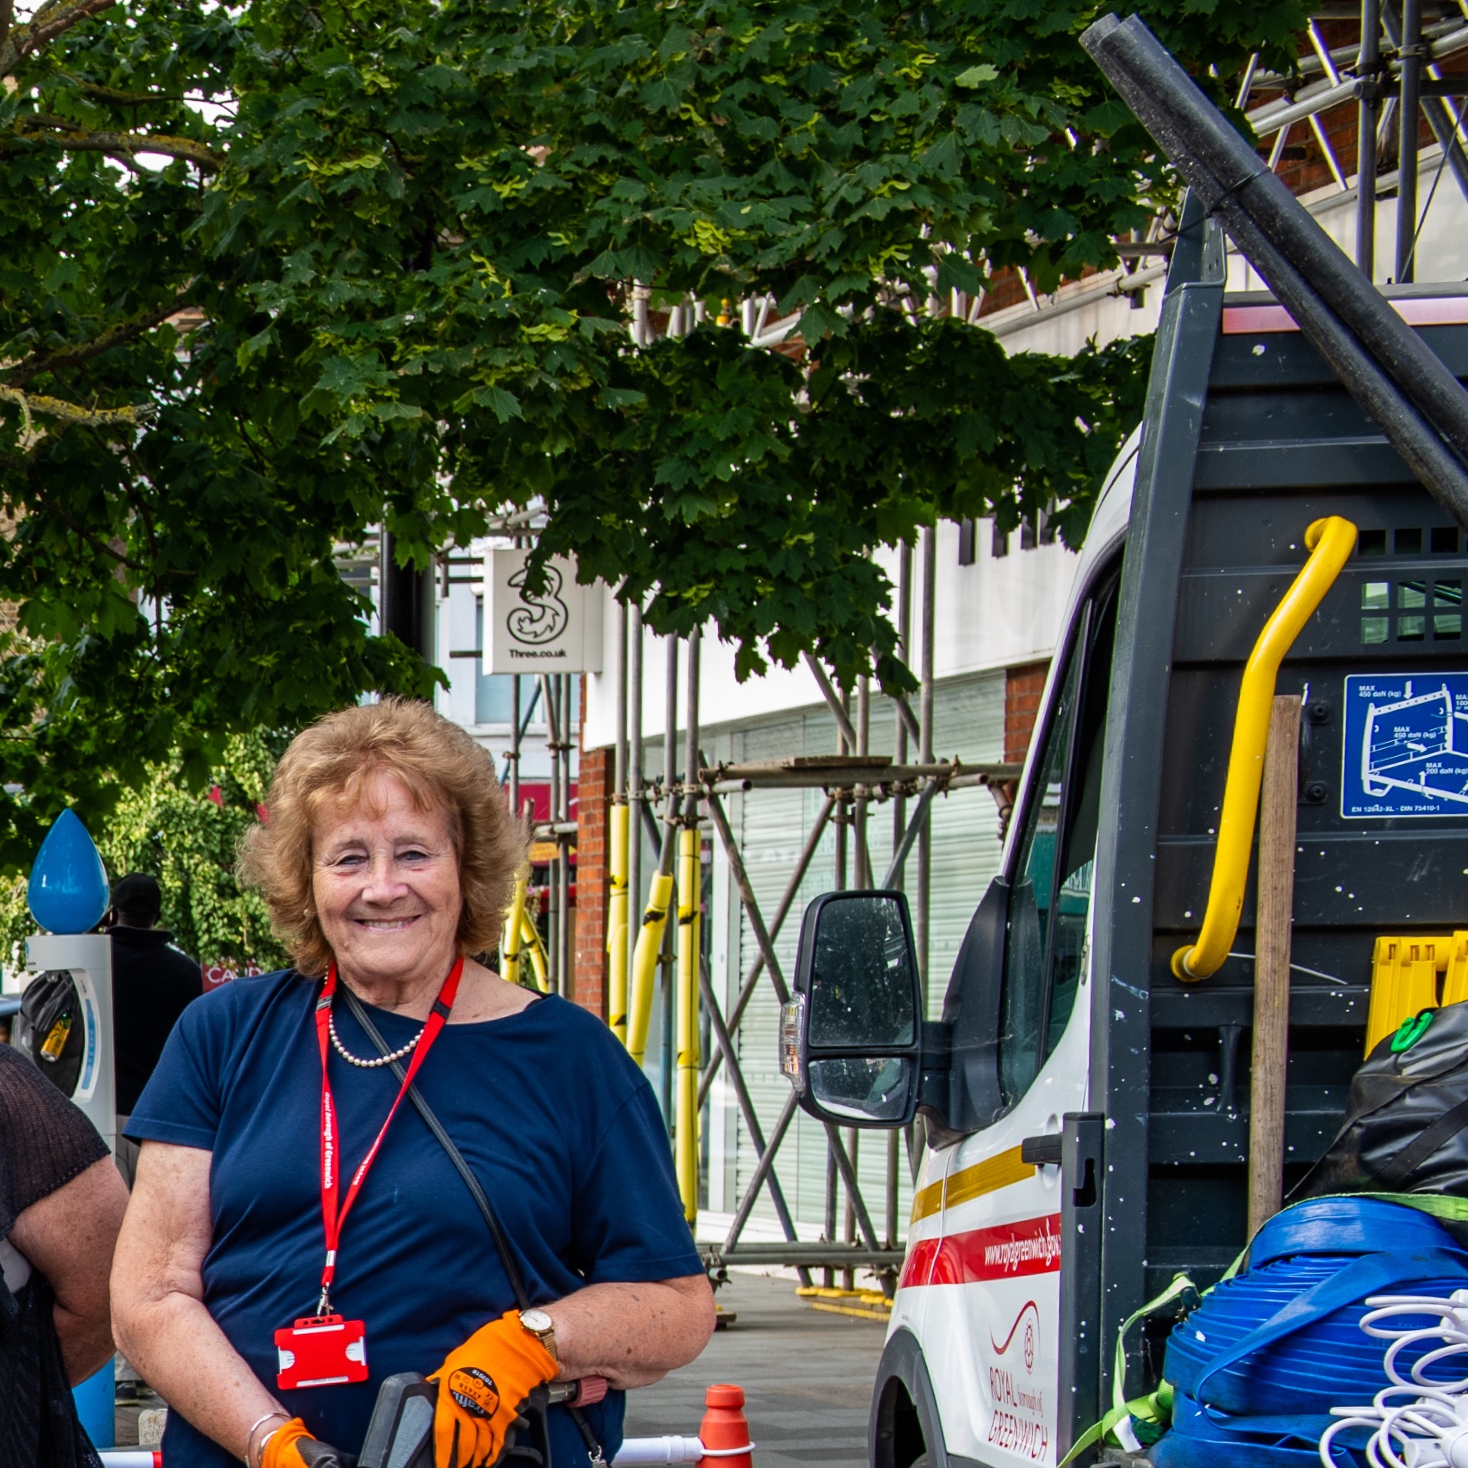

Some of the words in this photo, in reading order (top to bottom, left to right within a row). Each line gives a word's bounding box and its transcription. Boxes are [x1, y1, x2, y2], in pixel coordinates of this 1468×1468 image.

[509, 649, 567, 659] Three.co.uk
[324, 1112, 333, 1141] Borough
[325, 1142, 333, 1150] of
[324, 1150, 333, 1189] Greenwich
[989, 1366, 1018, 1407] ROYAL
[988, 1409, 1049, 1462] GREENWICH
